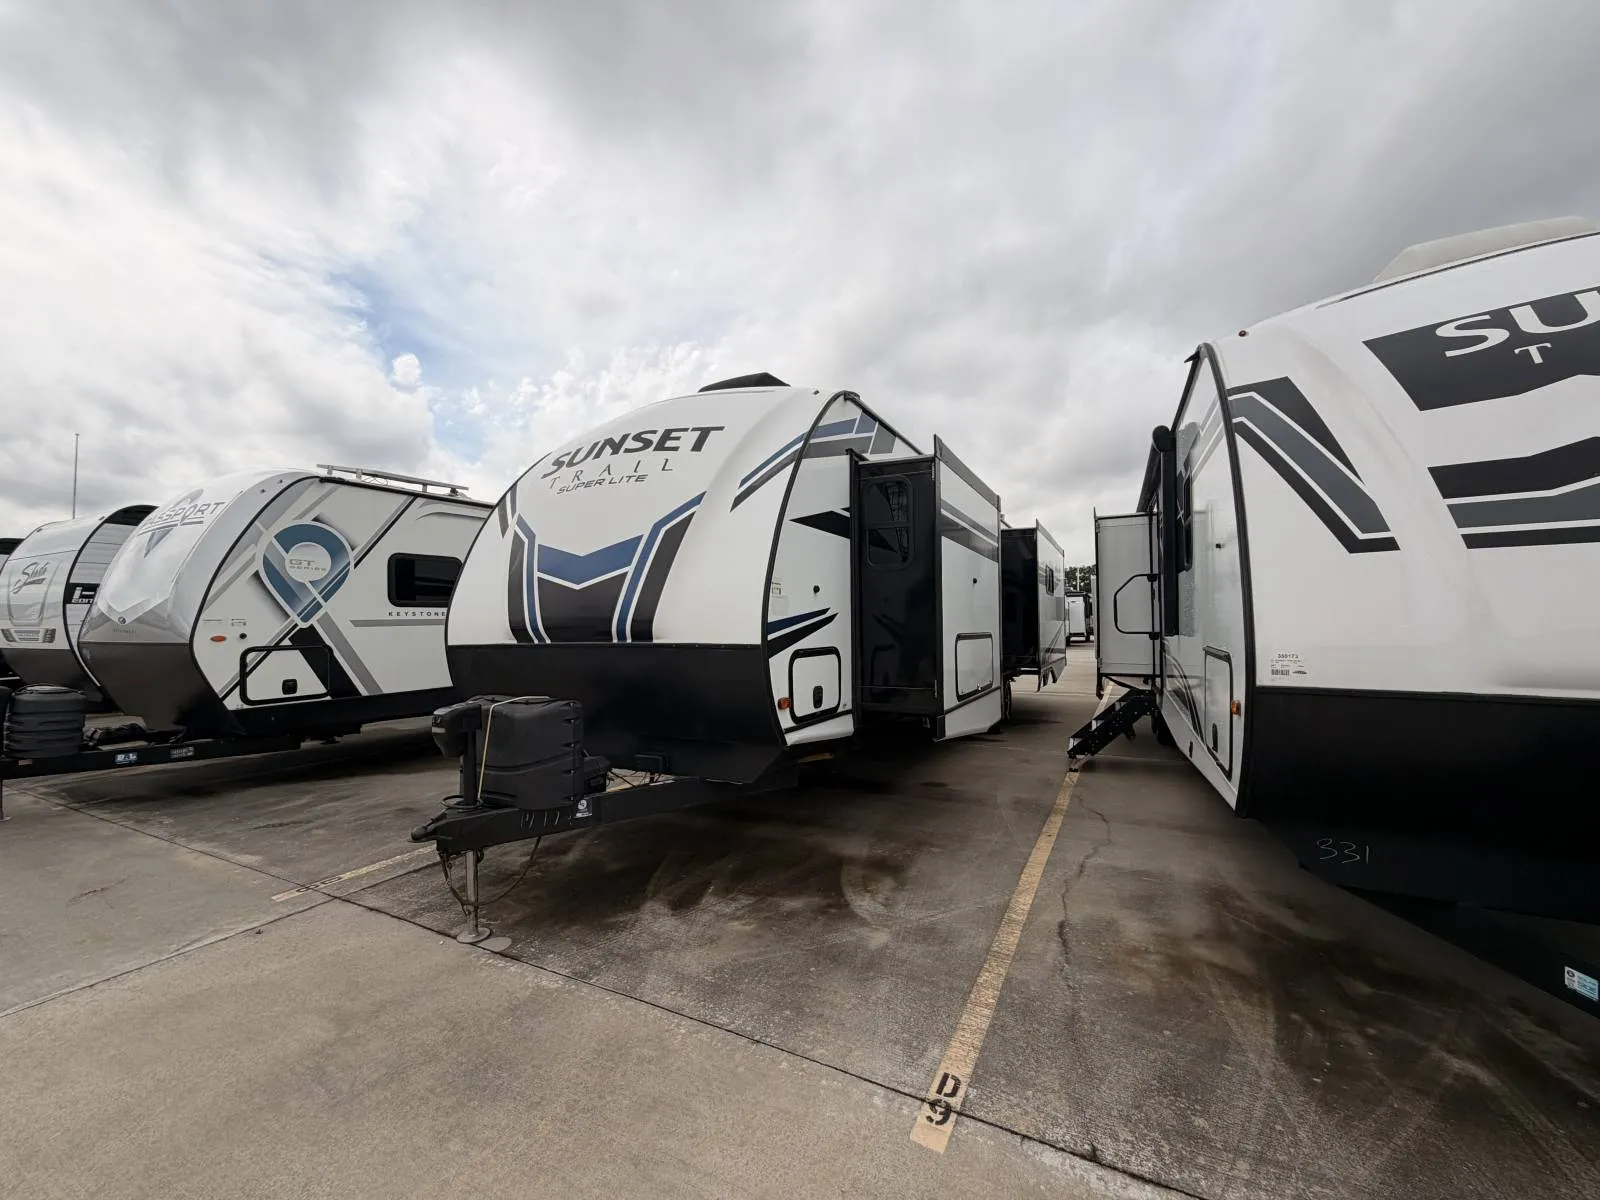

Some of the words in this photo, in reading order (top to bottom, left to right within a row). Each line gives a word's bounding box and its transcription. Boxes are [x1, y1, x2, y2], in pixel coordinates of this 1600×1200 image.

[1435, 290, 1600, 357] SU
[1513, 342, 1552, 364] T
[541, 426, 725, 479] SUNSET
[550, 458, 673, 489] TRAIL
[556, 478, 606, 495] SUPER
[608, 474, 649, 485] LITE
[1316, 838, 1369, 864] 331
[936, 1072, 961, 1097] D
[926, 1098, 952, 1125] 9
